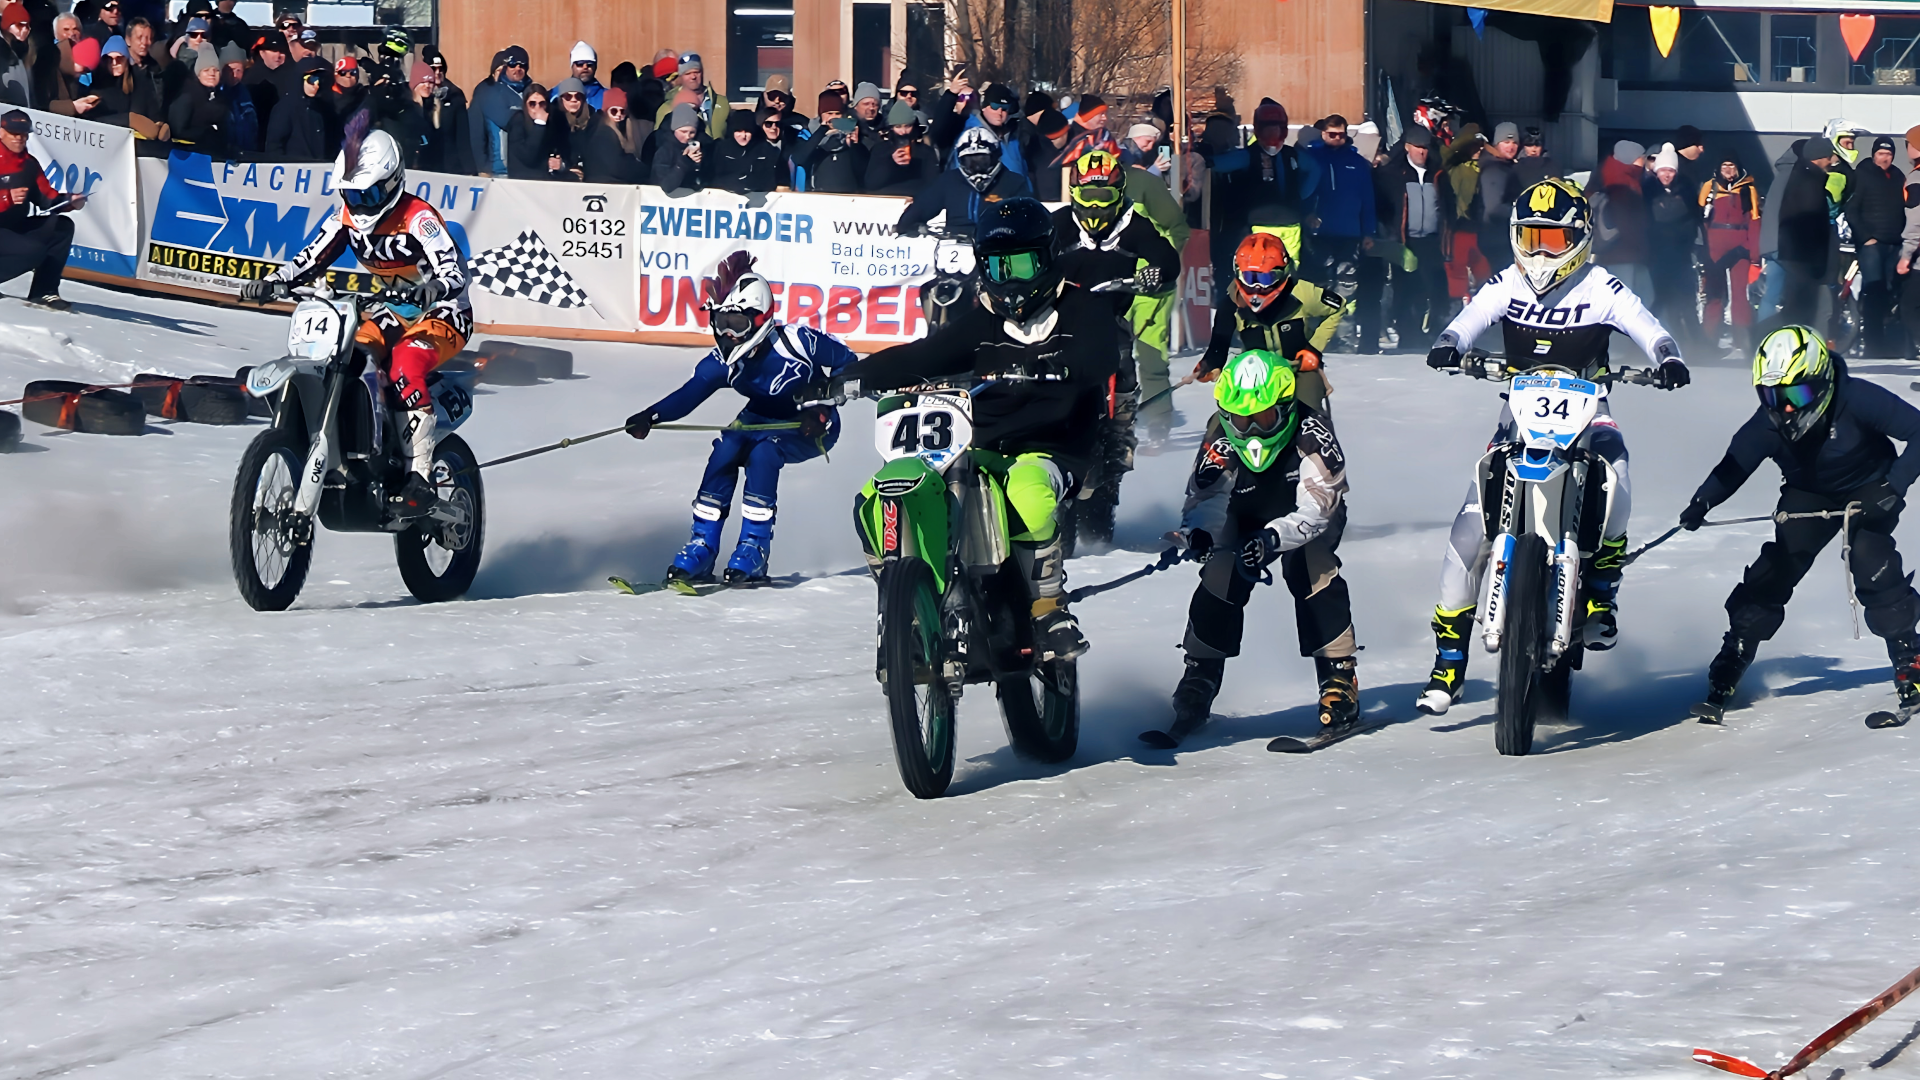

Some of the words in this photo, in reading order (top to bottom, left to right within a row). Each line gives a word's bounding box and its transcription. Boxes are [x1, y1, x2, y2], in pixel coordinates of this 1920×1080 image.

[223, 163, 484, 211] FACHDONT
[562, 217, 626, 236] 06132
[640, 203, 814, 244] ZWEIRÄDER
[562, 240, 623, 259] 25451
[640, 250, 690, 270] von
[831, 242, 864, 258] Bad
[871, 244, 911, 259] Ischl
[949, 250, 959, 263] 2
[831, 261, 860, 276] Tel.
[639, 273, 926, 336] UNERBE
[1507, 297, 1591, 326] SHOT
[304, 316, 329, 335] 14
[1534, 396, 1570, 420] 34
[891, 410, 954, 455] 43
[1489, 571, 1505, 623] UNLOP
[1556, 567, 1567, 626] DUNLOP
